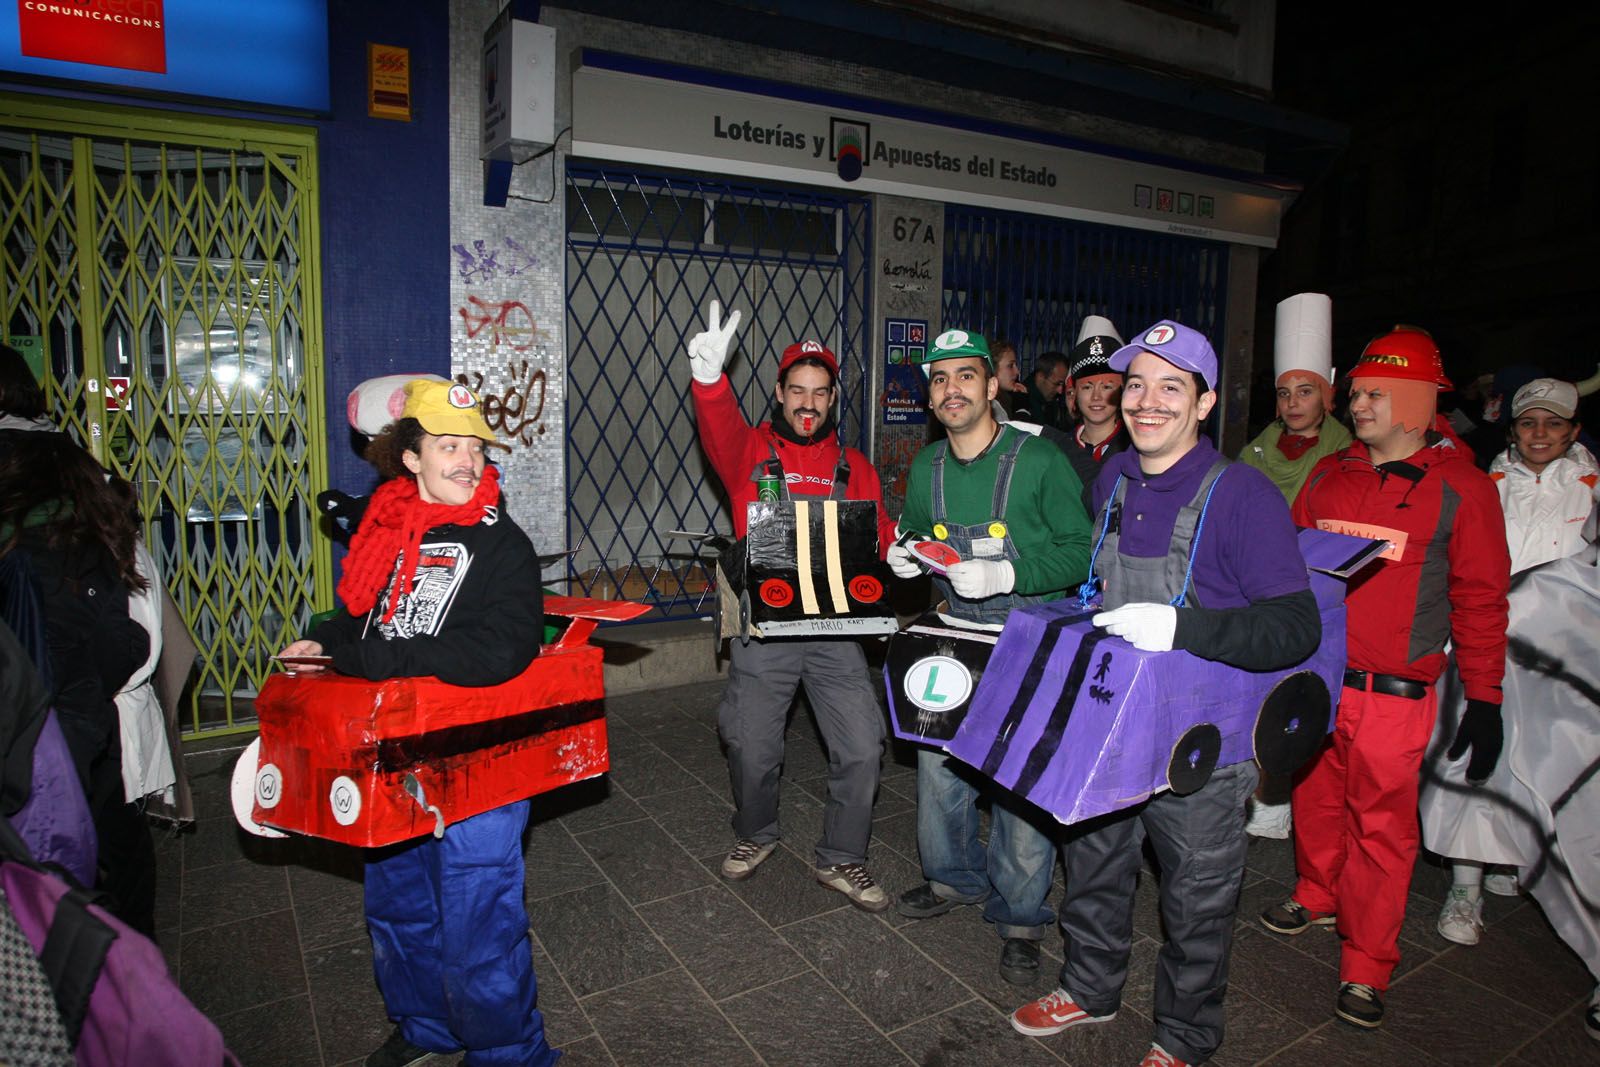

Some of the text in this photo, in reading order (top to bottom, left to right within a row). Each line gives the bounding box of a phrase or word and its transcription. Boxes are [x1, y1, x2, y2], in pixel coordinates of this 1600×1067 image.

[24, 1, 161, 29] COMUNICACIONS
[714, 115, 1057, 188] Loterías y Apuestas del Estado
[946, 333, 960, 345] L
[803, 340, 822, 353] M
[887, 405, 913, 413] Apuestas
[887, 413, 908, 421] Estado
[811, 621, 843, 631] MARIO
[922, 665, 948, 704] L
